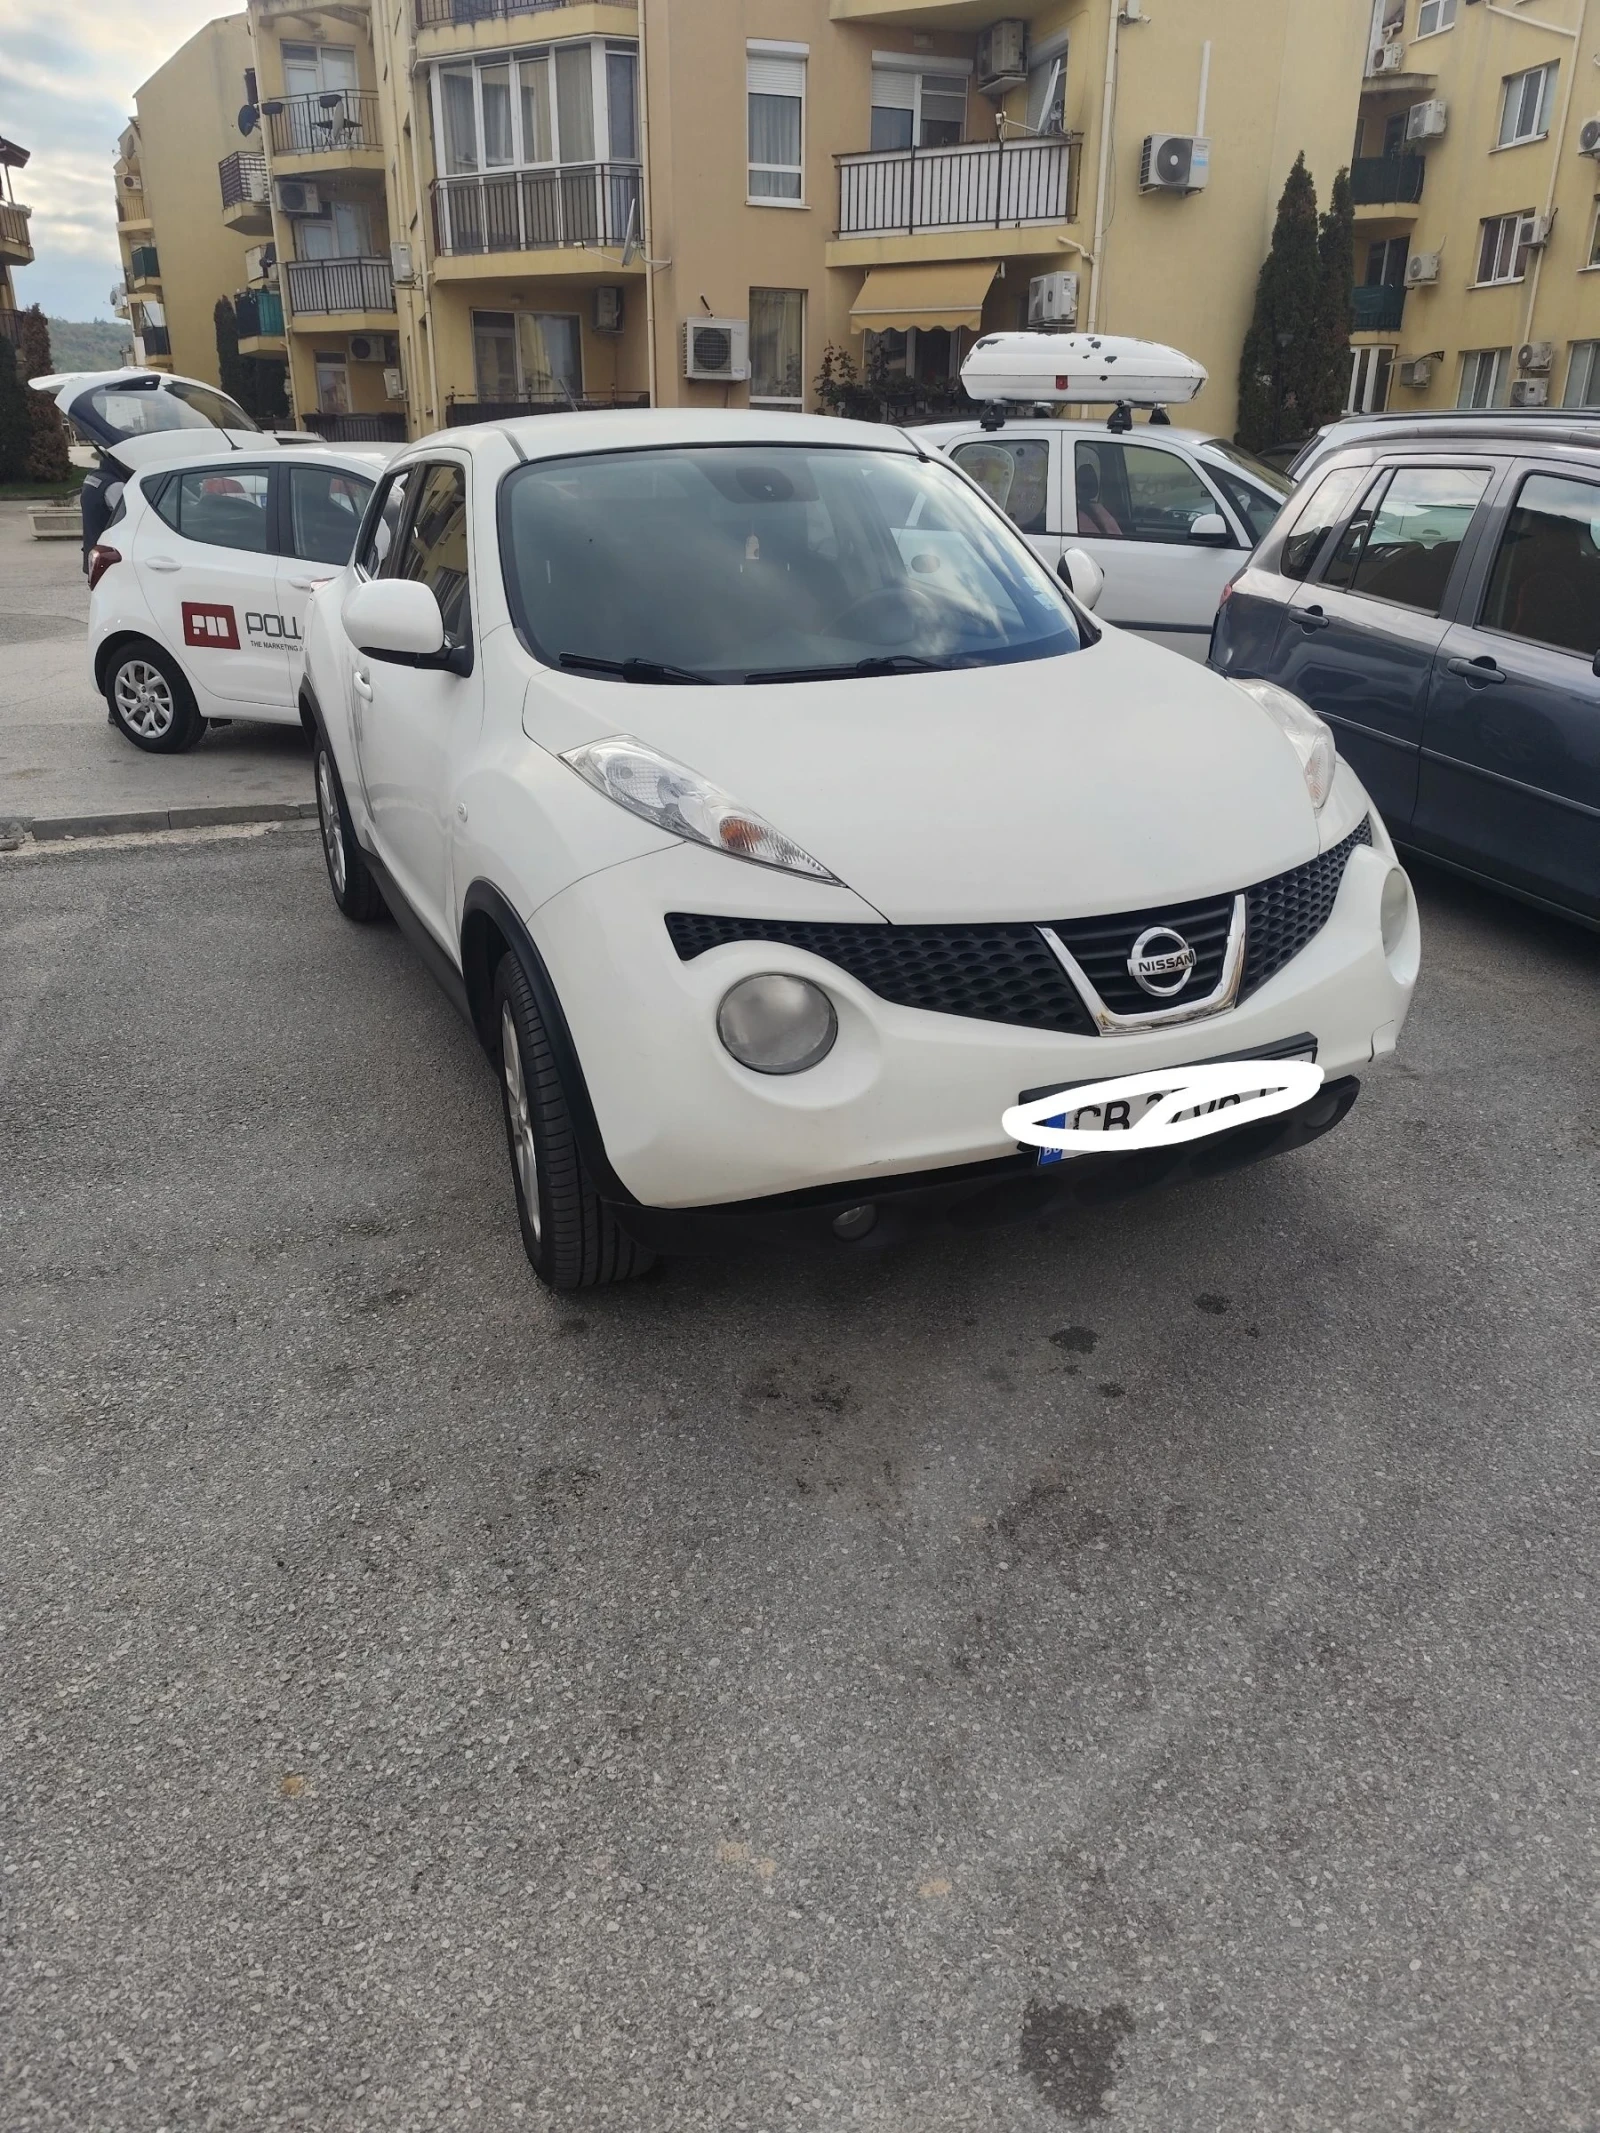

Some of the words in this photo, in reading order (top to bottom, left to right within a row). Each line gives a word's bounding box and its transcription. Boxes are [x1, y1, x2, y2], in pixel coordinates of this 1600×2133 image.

[250, 640, 263, 648] THE
[263, 641, 298, 652] MARKETING
[1138, 951, 1193, 972] NISSAN
